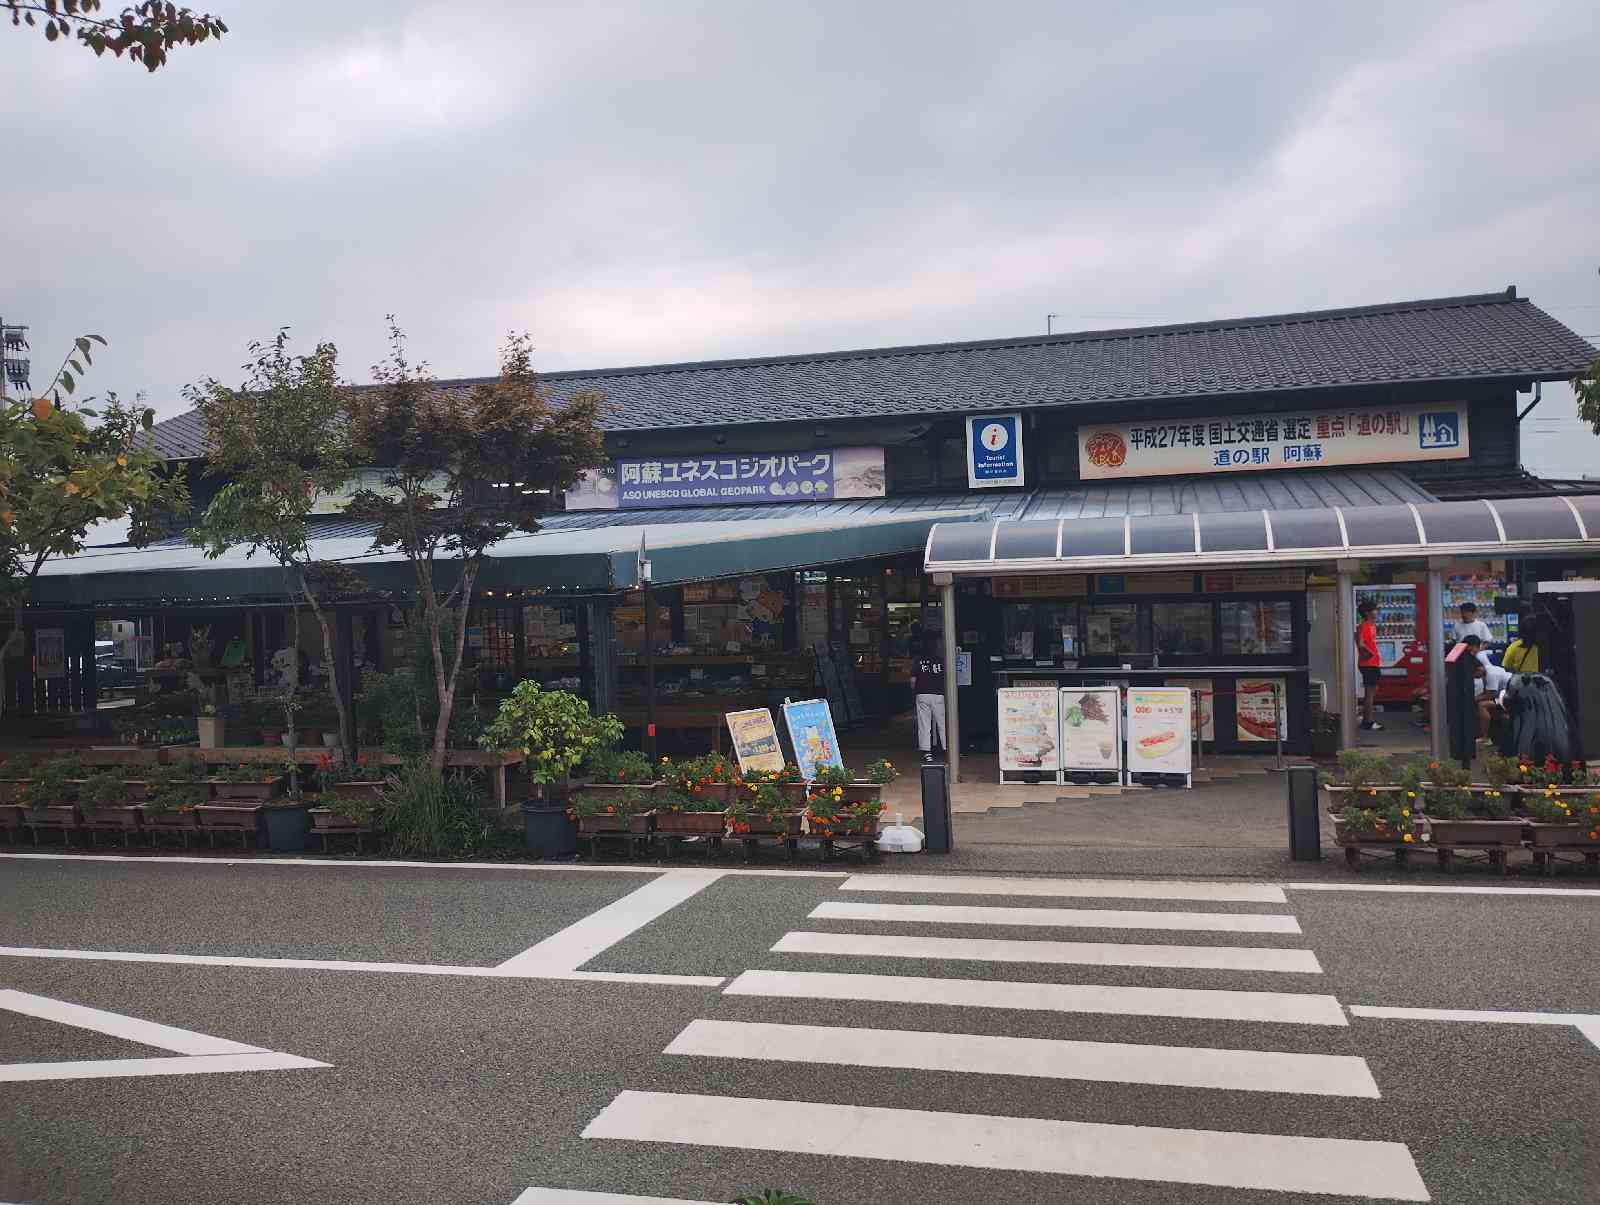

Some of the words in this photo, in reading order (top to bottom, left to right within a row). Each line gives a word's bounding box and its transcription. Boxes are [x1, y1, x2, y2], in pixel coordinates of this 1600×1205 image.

[1130, 424, 1206, 450] 平成27年度
[1208, 419, 1279, 445] 国土交通省
[1283, 417, 1312, 441] 選定
[1213, 447, 1271, 467] 道の駅
[1283, 444, 1323, 463] 阿蘇
[620, 454, 831, 485] 阿蘇ユネスコジオパーク
[622, 490, 642, 500] ASO
[643, 488, 680, 499] UNESCO
[681, 486, 718, 498] GLOBAL
[720, 485, 767, 496] GEOPARK
